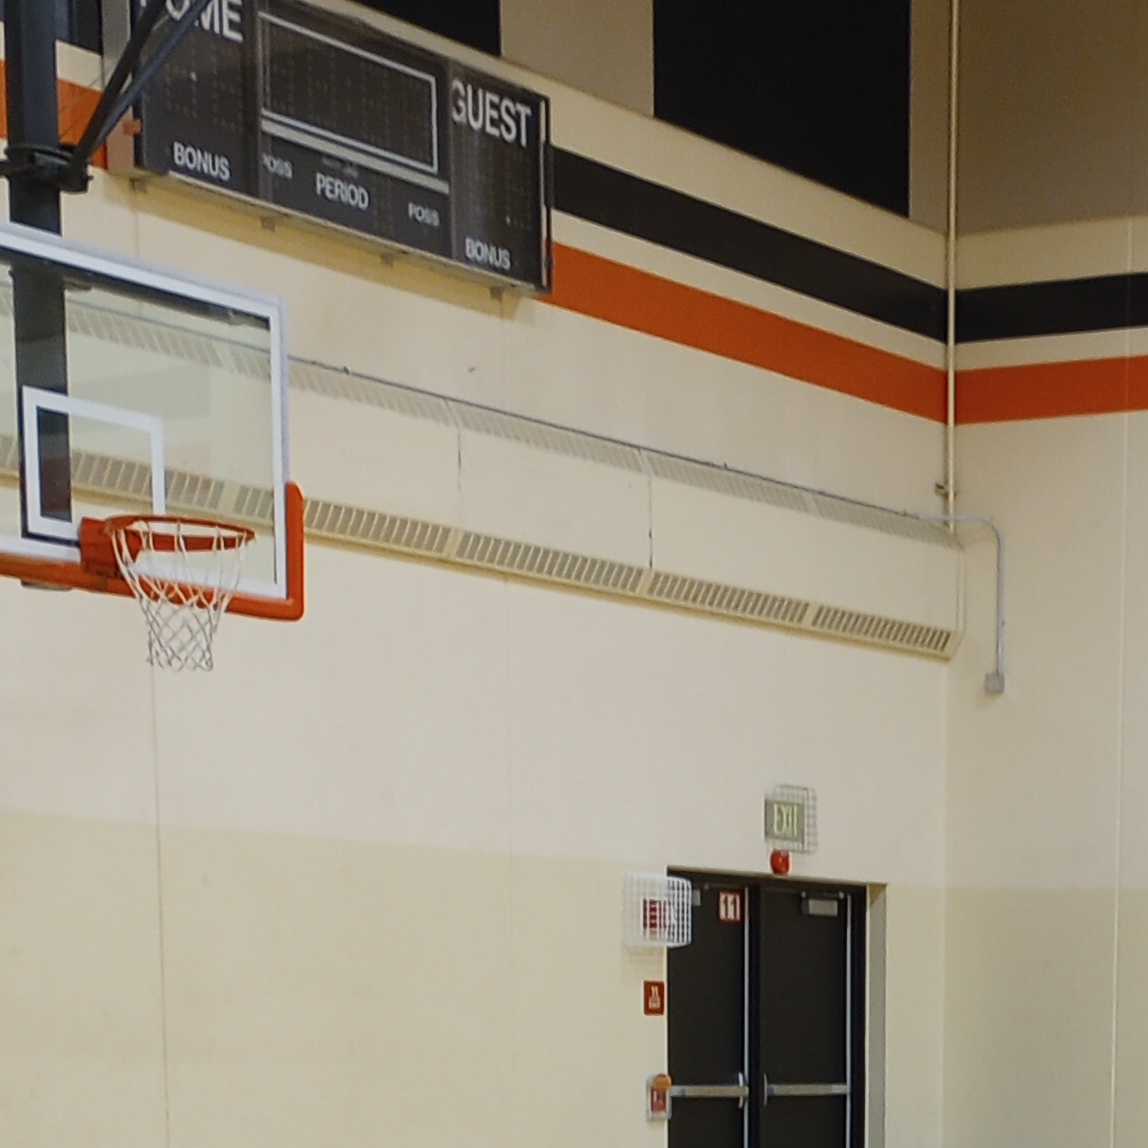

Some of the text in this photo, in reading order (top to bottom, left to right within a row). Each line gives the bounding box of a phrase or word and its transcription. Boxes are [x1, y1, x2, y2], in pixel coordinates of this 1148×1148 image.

[140, 0, 243, 42] OME
[450, 78, 532, 147] GUEST
[173, 141, 230, 181] BONUS
[316, 172, 369, 210] PERIOD
[465, 237, 511, 271] BONUS
